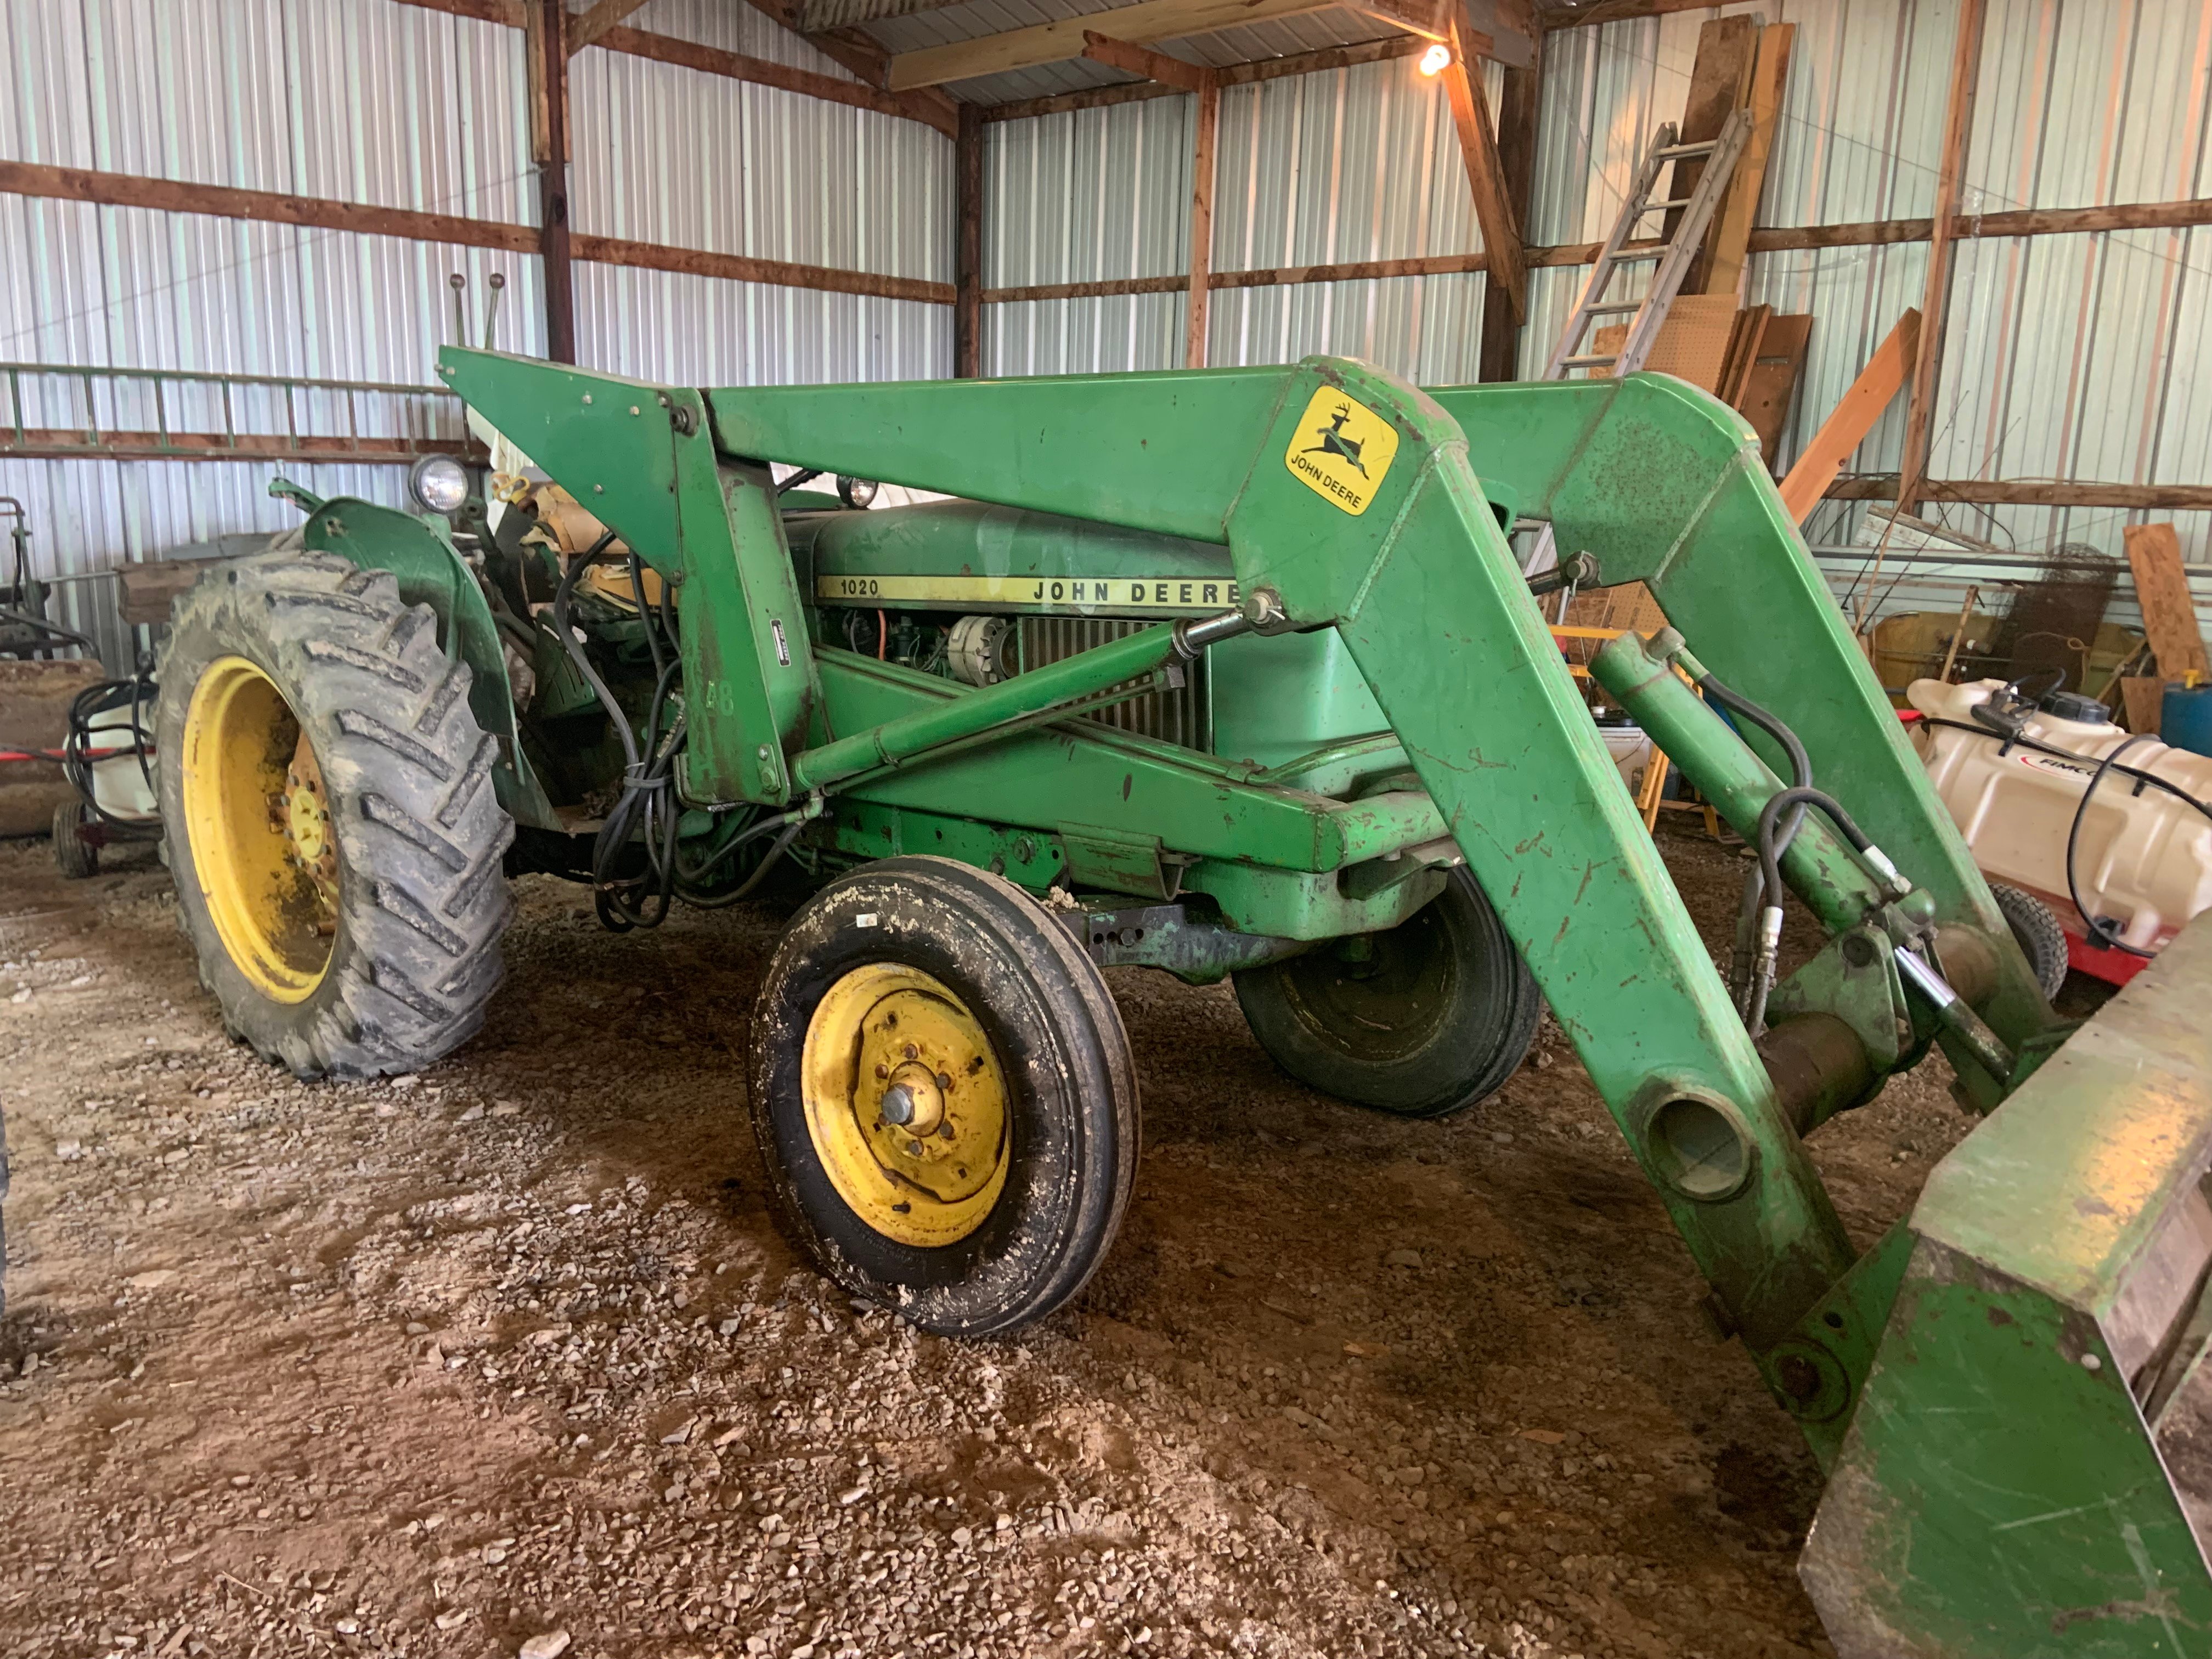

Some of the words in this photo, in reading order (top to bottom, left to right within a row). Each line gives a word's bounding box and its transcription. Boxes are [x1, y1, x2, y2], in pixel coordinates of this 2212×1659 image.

[1291, 454, 1323, 481] JOHN
[1322, 475, 1362, 509] DEERE
[841, 579, 878, 595] 1020
[1034, 582, 1108, 601] JOHN
[1131, 583, 1240, 603] DEERE
